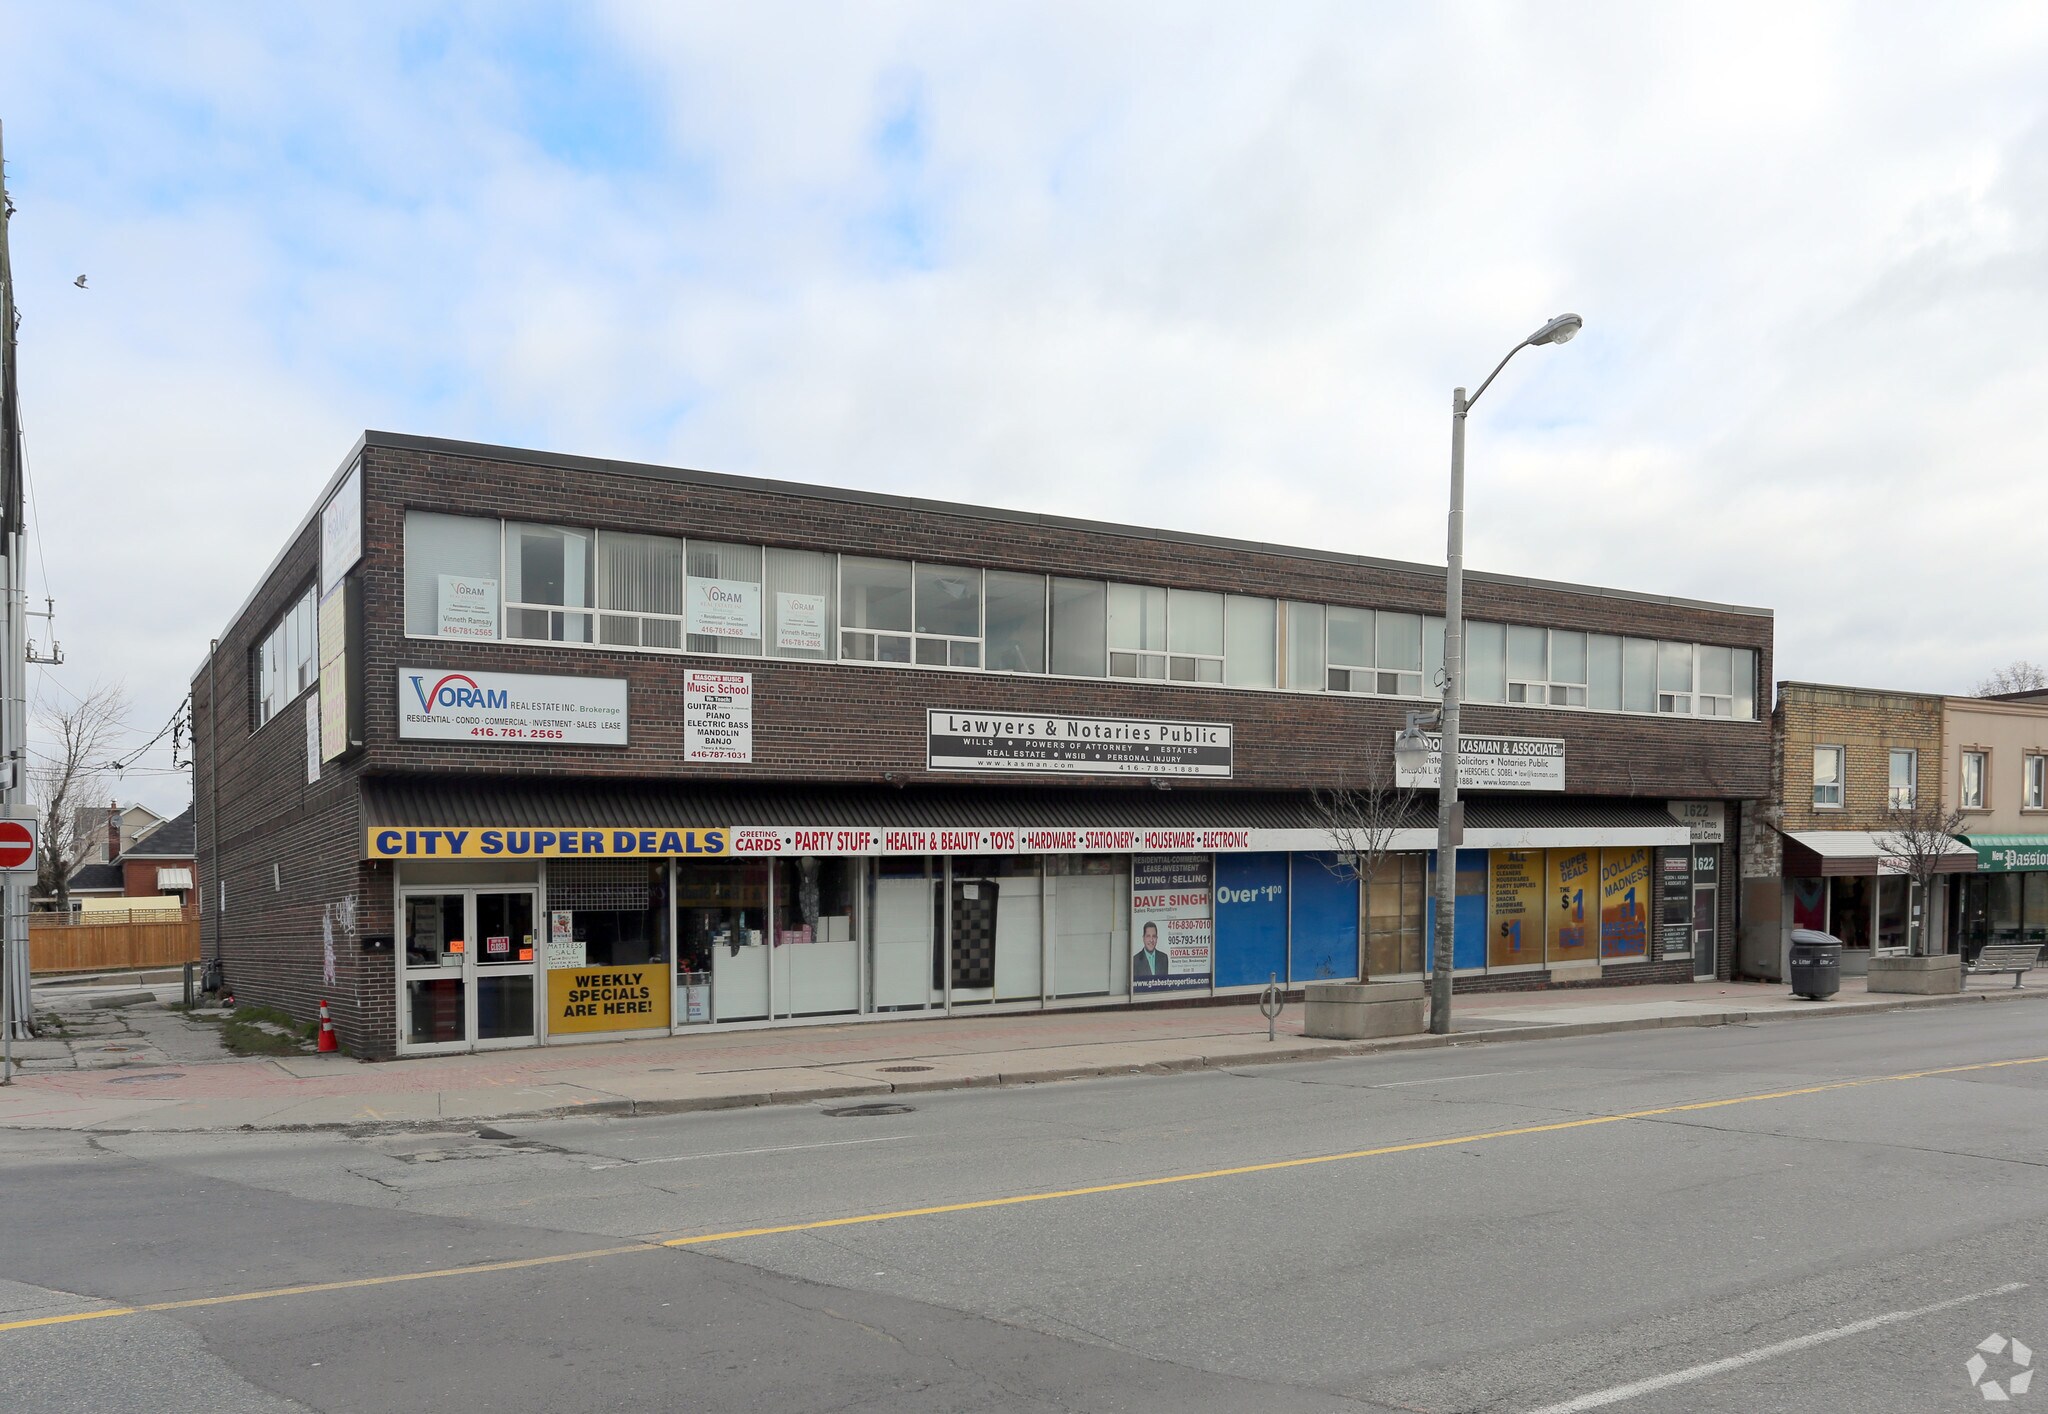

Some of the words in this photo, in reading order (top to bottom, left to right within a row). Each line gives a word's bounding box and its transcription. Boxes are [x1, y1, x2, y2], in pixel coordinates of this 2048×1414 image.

[443, 625, 493, 636] 416-781-2565
[701, 626, 744, 636] 416-781-2565
[781, 638, 821, 647] 416-781-2565
[409, 674, 508, 714] VORAM
[687, 682, 714, 693] Music
[718, 684, 749, 695] School
[510, 701, 531, 711] REAL
[531, 702, 560, 712] ESTATE
[561, 704, 578, 712] INC.
[579, 705, 620, 715] Brokerage
[406, 714, 451, 723] RESIDENTIAL
[455, 716, 480, 725] CONDO
[484, 717, 528, 726] COMMERCIAL
[532, 719, 572, 728] INVESTMENT
[576, 720, 597, 729] SALES
[601, 721, 622, 730] LEASE
[706, 712, 731, 720] PIANO
[687, 720, 726, 728] ELECTRIC
[949, 715, 1036, 738] Lawyers
[1045, 719, 1057, 736] &
[1067, 721, 1151, 741] Notaries
[1160, 726, 1218, 744] Public
[697, 729, 739, 737] MANDOLIN
[963, 738, 994, 746] WILLS
[1025, 740, 1065, 749] POWERS
[1069, 742, 1083, 750] OF
[1086, 743, 1133, 752] ATTORNEY
[1160, 746, 1199, 754] ESTATES
[1460, 739, 1500, 753] KASMAN
[1502, 742, 1510, 754] &
[691, 751, 746, 759] 416-787-1031
[987, 749, 1011, 757] REAL
[1013, 750, 1046, 758] ESTATE
[1064, 752, 1086, 760] WSIB
[1107, 754, 1150, 762] PERSONAL
[1153, 755, 1182, 763] INJURY
[1457, 756, 1489, 766] Solicitors
[1497, 758, 1527, 767] Notaries
[1528, 759, 1549, 768] Public
[977, 759, 1074, 769] www.kasman.com
[1119, 764, 1200, 773] 416-789-1888
[1464, 768, 1490, 776] HERSCHEL
[1497, 769, 1513, 777] SOBEL
[1518, 770, 1559, 778] law@kasman.com
[1483, 778, 1531, 787] www.kasman.com
[1683, 804, 1709, 817] 1622
[735, 838, 782, 851] CARDS
[795, 831, 834, 851] PARTY
[837, 831, 871, 851] STUFF
[886, 831, 926, 850] HEALTH
[929, 832, 938, 850] &
[941, 831, 981, 850] BEAUTY
[989, 831, 1015, 850] TOYS
[1027, 831, 1077, 849] HARDWARE
[1085, 831, 1135, 849] STATIONERY
[1144, 831, 1195, 849] HOUSEWARE
[1202, 831, 1248, 848] ELECTRONIC
[739, 830, 778, 838] GREETING
[1703, 830, 1722, 840] Centre
[376, 830, 472, 855] CITY
[480, 830, 605, 855] SUPER
[612, 831, 725, 854] DEALS
[1508, 853, 1527, 862] ALL
[1559, 851, 1587, 871] SUPER
[1602, 848, 1645, 881] DOLLAR
[1694, 857, 1715, 871] 1622
[1134, 876, 1166, 884] BUYING
[1172, 875, 1208, 883] SELLING
[1561, 863, 1589, 882] DEALS
[1604, 865, 1649, 898] MADNESS
[1133, 895, 1166, 908] DAVE
[1169, 894, 1208, 906] SINGH
[1217, 886, 1258, 904] Over
[1167, 920, 1211, 930] 416-830-7010
[1601, 921, 1646, 937] MEGA
[1167, 935, 1211, 945] 905-793-1111
[1601, 938, 1645, 956] STORE
[1191, 948, 1209, 956] STAR
[575, 973, 643, 988] WEEKLY
[569, 987, 650, 1003] SPECIALS
[564, 1003, 597, 1018] ARE
[603, 1001, 652, 1015] HERE!
